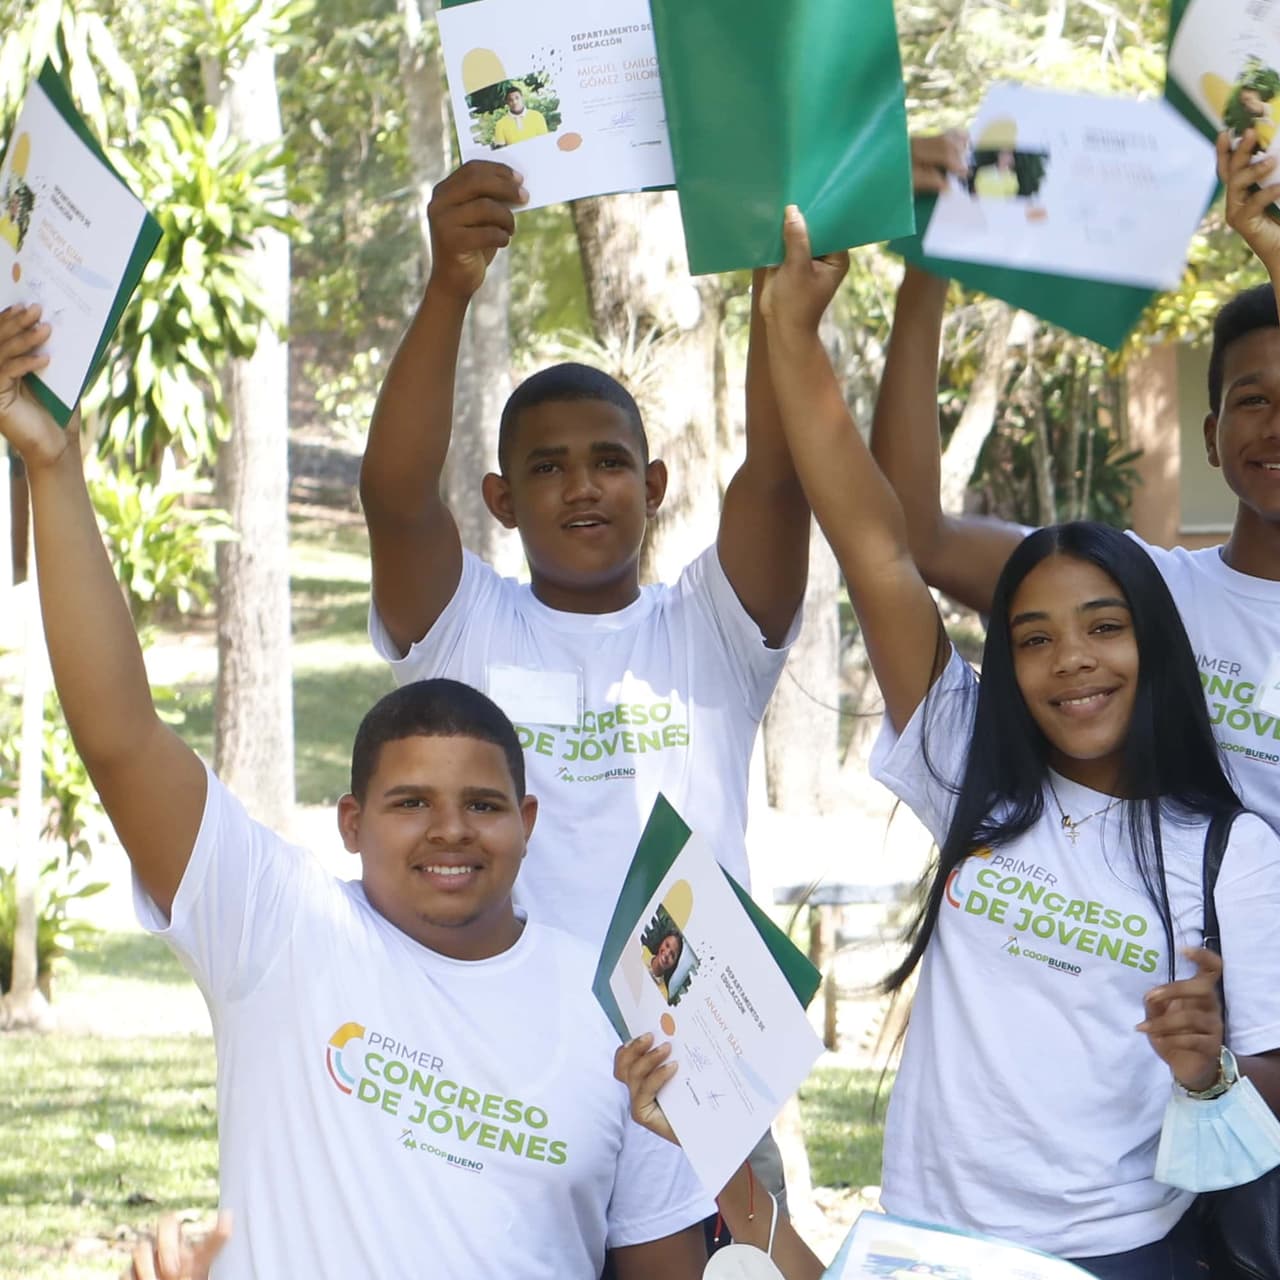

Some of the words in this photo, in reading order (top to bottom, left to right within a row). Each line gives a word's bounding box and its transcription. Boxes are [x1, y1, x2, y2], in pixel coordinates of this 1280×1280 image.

[571, 24, 639, 42] DEPARTAMENTO
[572, 37, 622, 51] EDUCACIÓN
[515, 727, 555, 756] DE
[562, 723, 690, 762] JÓVENES
[989, 855, 1059, 887] PRIMER
[976, 868, 1148, 937] CONGRESO
[964, 890, 1009, 924] DE
[1013, 907, 1160, 974] JÓVENES
[1022, 948, 1082, 974] COOPBUENO
[367, 1031, 445, 1073] PRIMER
[364, 1052, 549, 1130] CONGRESO
[356, 1077, 402, 1116] DE
[408, 1100, 568, 1166] JÓVENES
[420, 1142, 484, 1171] COOPBUENO
